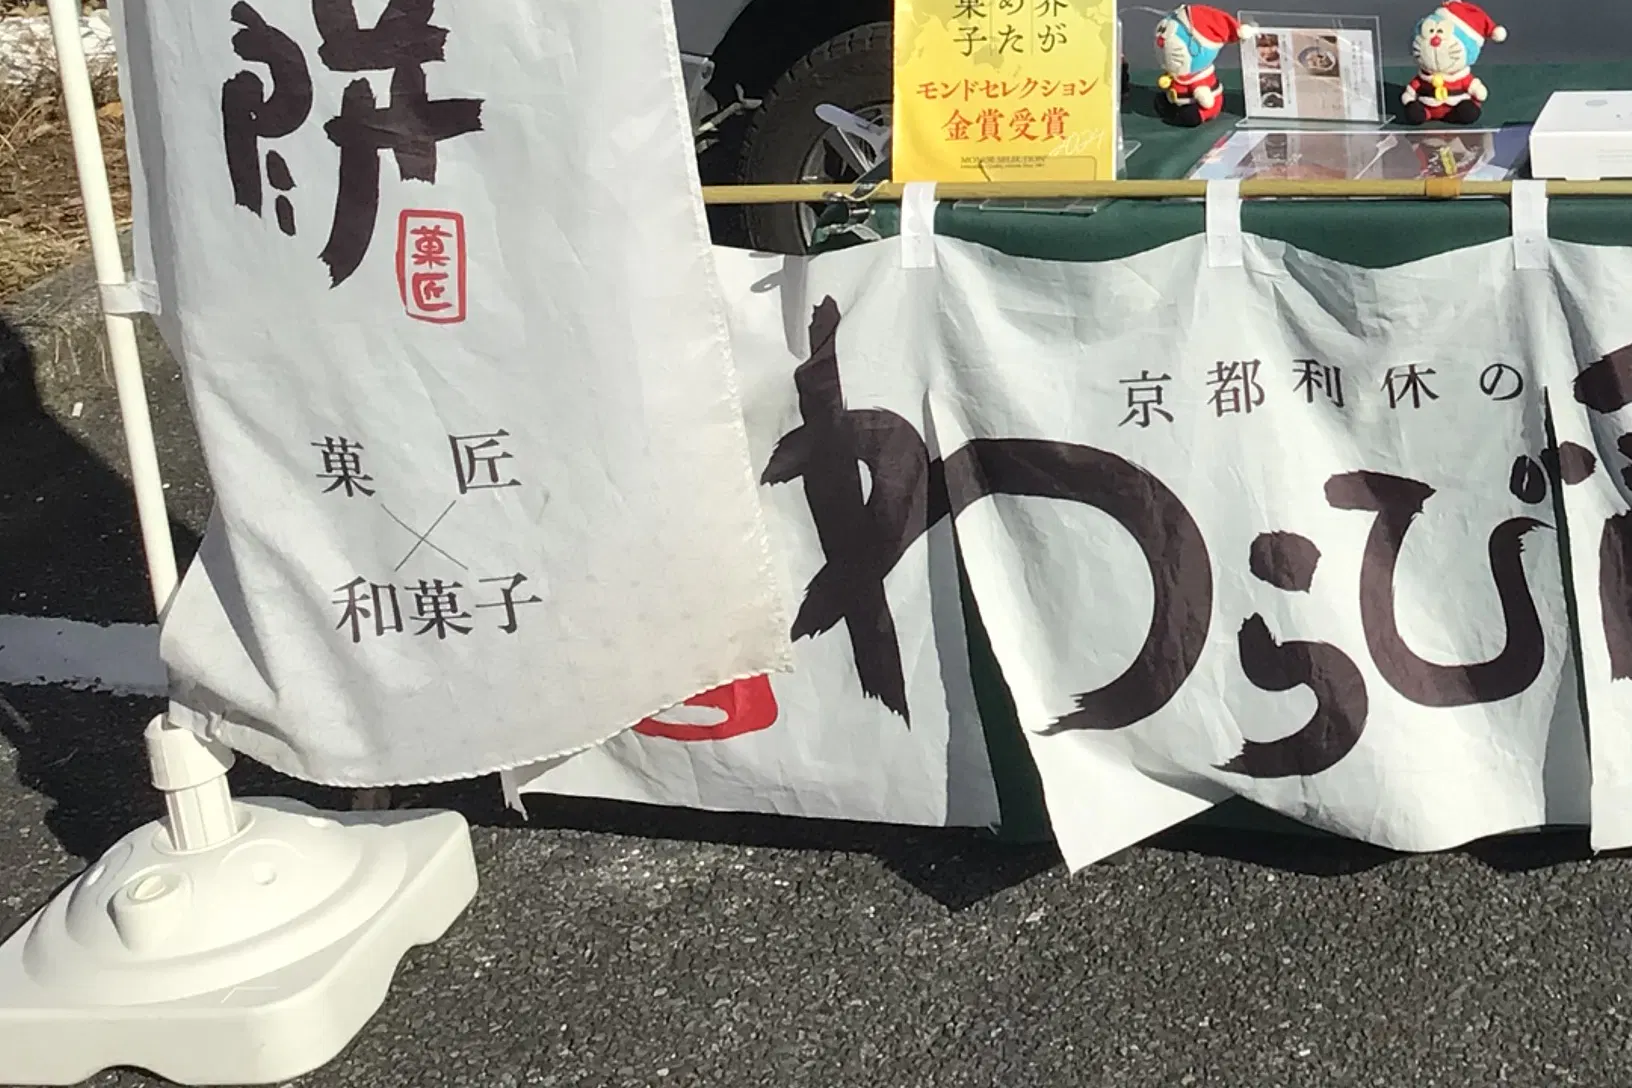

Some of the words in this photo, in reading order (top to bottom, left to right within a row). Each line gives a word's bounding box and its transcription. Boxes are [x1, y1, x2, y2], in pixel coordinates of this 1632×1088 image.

[916, 77, 1099, 102] モンドセレクション
[941, 107, 1070, 143] 金賞受賞
[1117, 358, 1526, 428] 京都利休の
[330, 572, 543, 643] 和菓子
